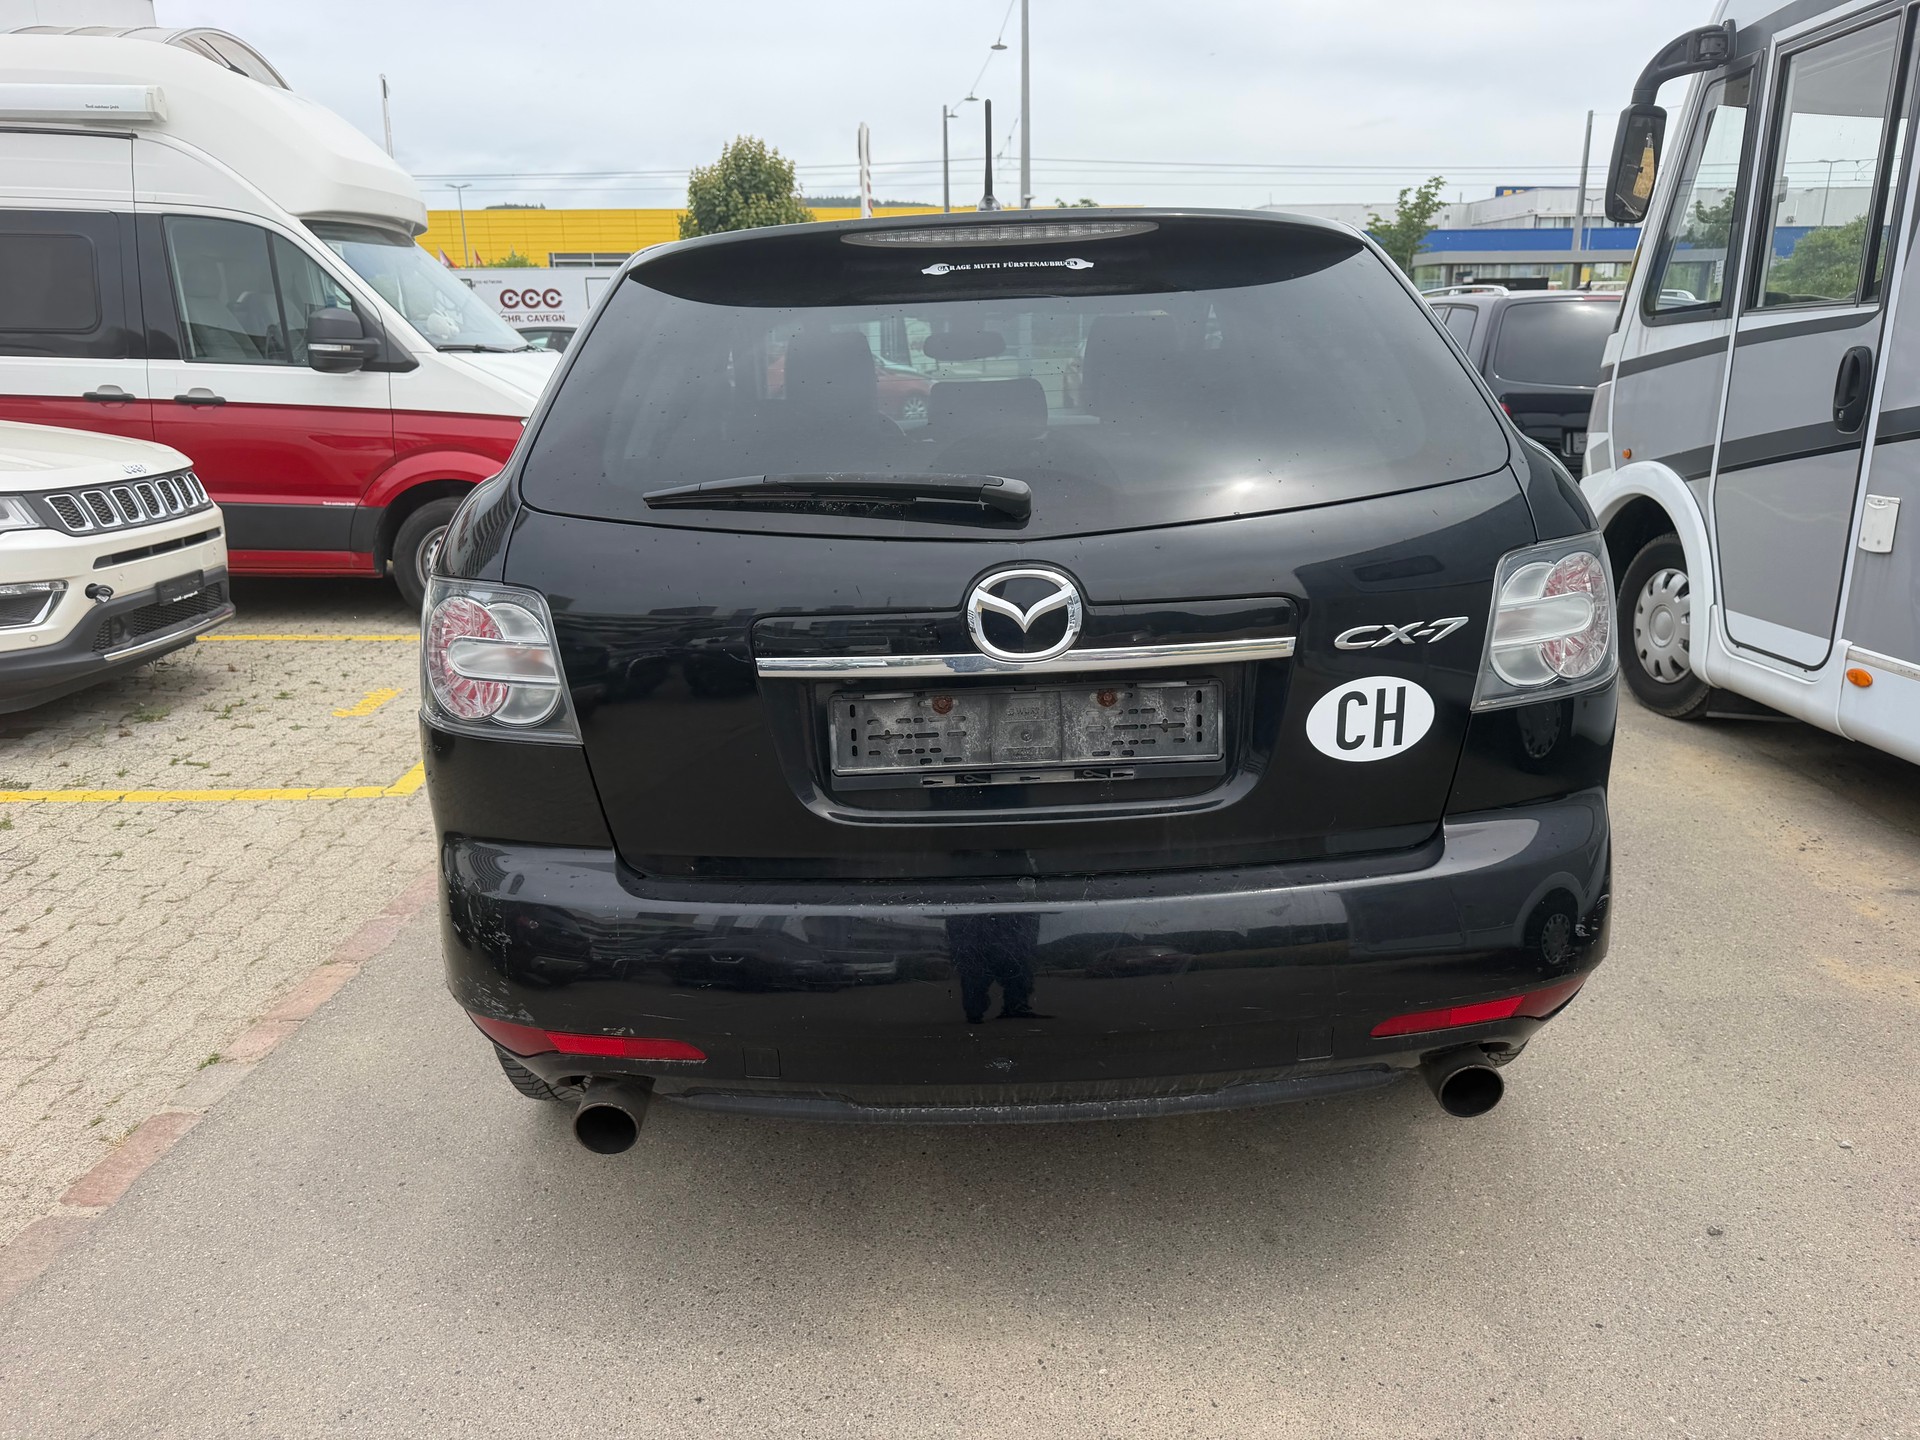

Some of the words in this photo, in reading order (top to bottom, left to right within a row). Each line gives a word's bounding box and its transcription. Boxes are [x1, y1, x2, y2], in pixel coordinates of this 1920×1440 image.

[938, 264, 971, 272] GARAGE
[499, 288, 563, 309] CCC
[527, 314, 566, 322] CAVEGN
[1334, 616, 1469, 650] CX-7
[1335, 686, 1406, 751] CH
